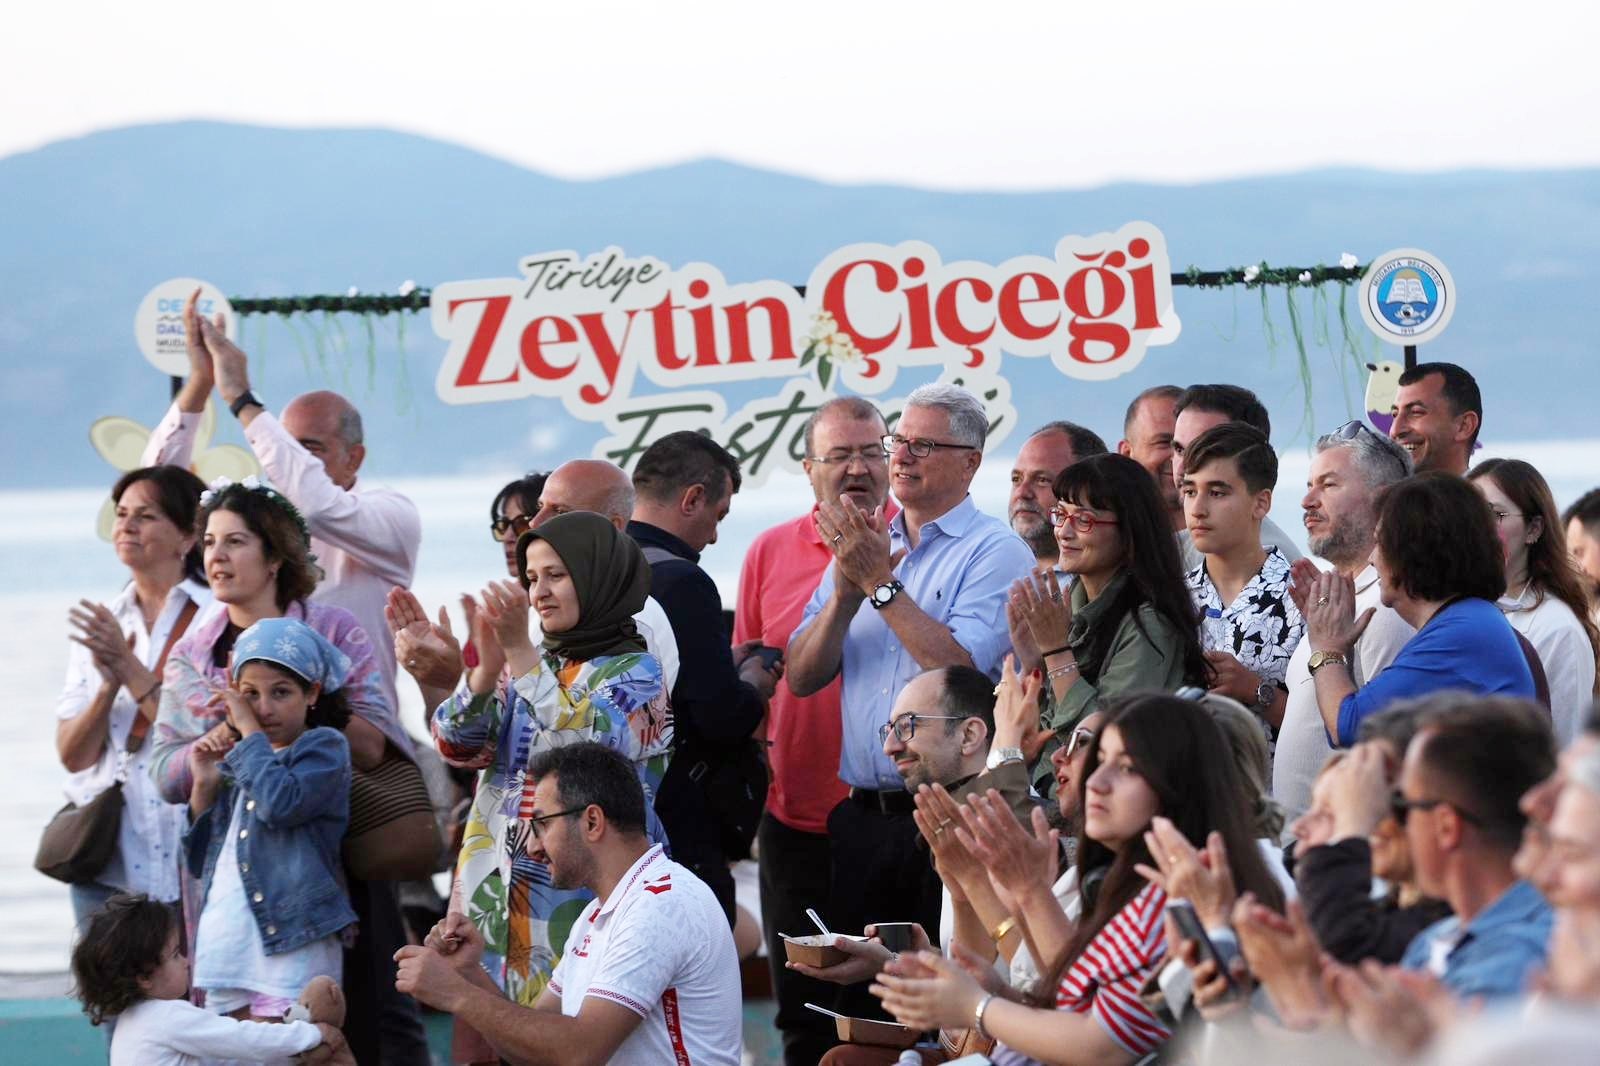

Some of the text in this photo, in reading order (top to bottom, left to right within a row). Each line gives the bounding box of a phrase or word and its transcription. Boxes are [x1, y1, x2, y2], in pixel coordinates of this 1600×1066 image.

[524, 253, 662, 303] Tirilye
[157, 298, 216, 313] DEZ
[447, 237, 1165, 405] Zeytin Çiçeği
